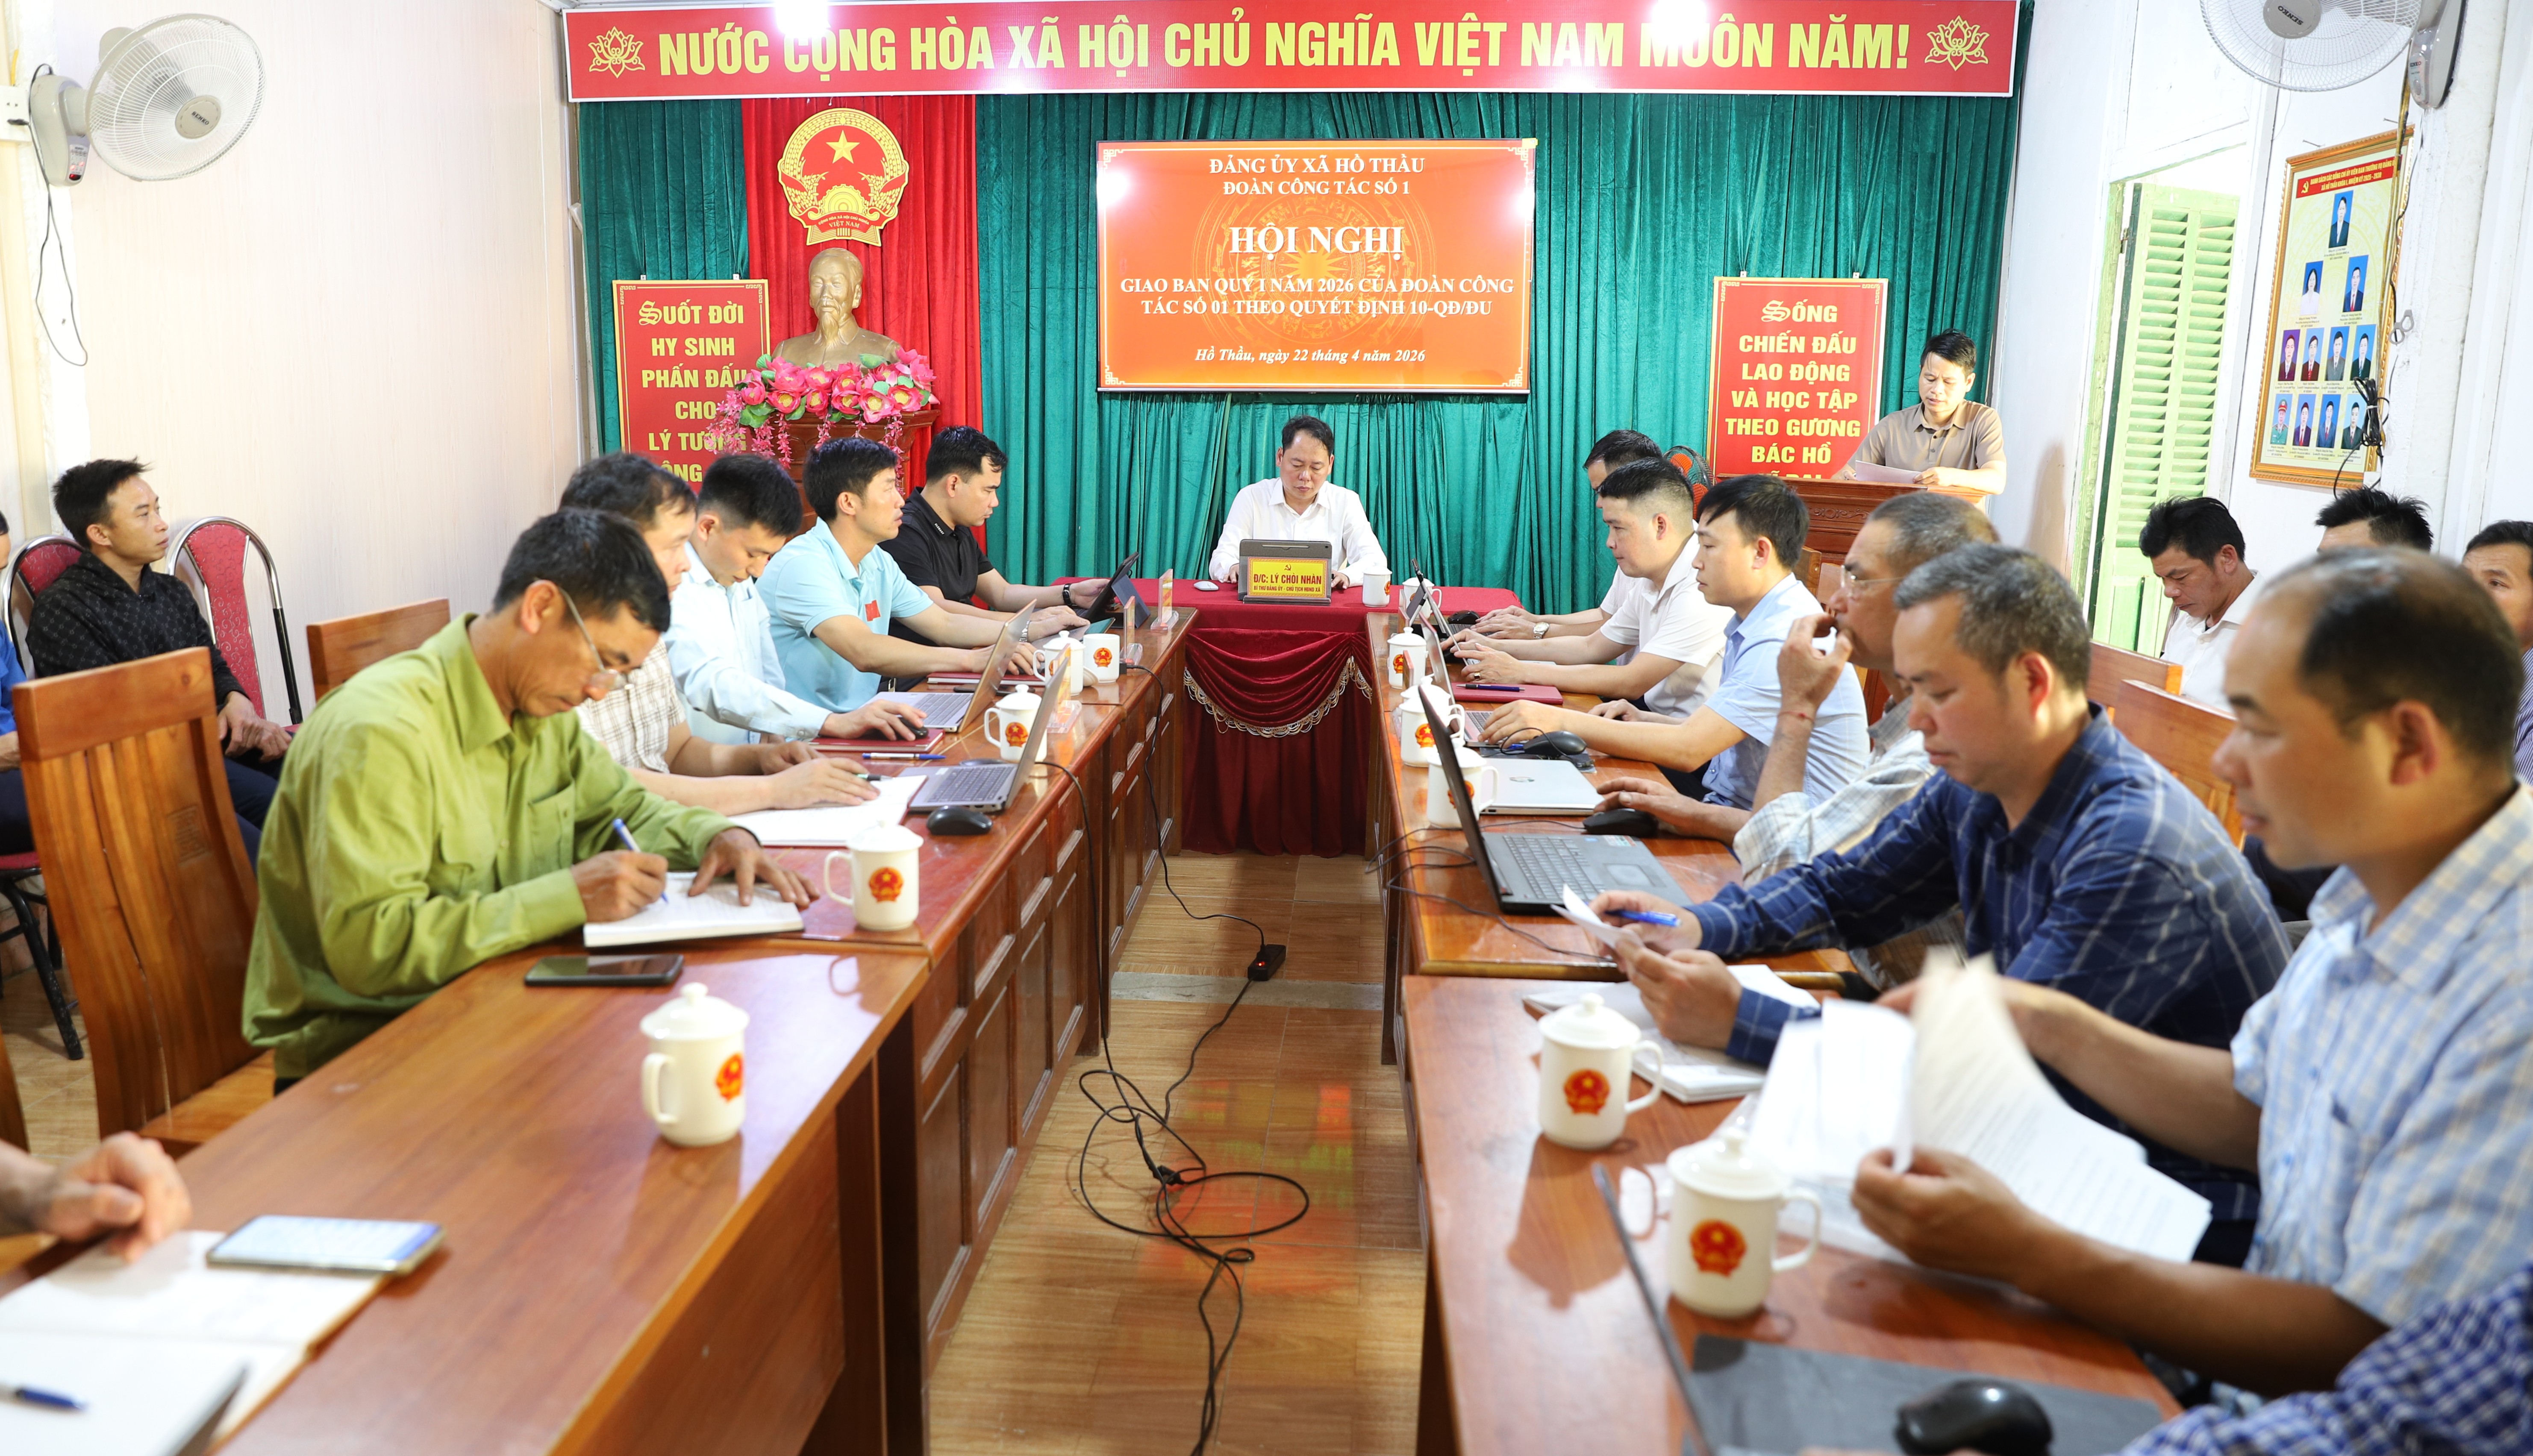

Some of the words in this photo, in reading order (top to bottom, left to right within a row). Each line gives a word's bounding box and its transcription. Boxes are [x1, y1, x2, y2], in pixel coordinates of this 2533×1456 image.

[2278, 6, 2304, 25] SENKO
[659, 23, 769, 75] NƯỚC
[911, 16, 994, 70] HÒA
[1007, 16, 1065, 68] XÃ
[1080, 15, 1148, 77] HỘI
[1165, 7, 1249, 67] CHỦ
[1266, 13, 1400, 66] NGHĨA
[1415, 13, 1507, 76] VIỆT
[1521, 23, 1624, 67] NAM
[1639, 13, 1774, 68] MUÔN
[1789, 14, 1909, 68] NĂM!
[191, 111, 209, 125] SENKO
[1210, 155, 1266, 173] ĐẢNG
[1271, 154, 1298, 173] ỦY
[1302, 155, 1330, 173] XÃ
[1336, 154, 1364, 173] HỒ
[1369, 154, 1425, 172] THẦU
[1224, 178, 1274, 194] ĐOÀN
[1278, 178, 1330, 194] CÔNG
[1334, 177, 1370, 194] TÁC
[1375, 177, 1397, 194] SỐ
[1403, 181, 1409, 194] 1
[1230, 223, 1298, 260] HỘI
[1308, 226, 1404, 260] NGHỊ
[1121, 279, 1168, 292] GIAO
[1173, 279, 1209, 292] BAN
[1215, 274, 1253, 295] QUÝ
[1259, 279, 1265, 291] I
[1270, 275, 1313, 292] NĂM
[1318, 279, 1353, 292] 2026
[1359, 273, 1397, 293] CỦA
[1401, 275, 1454, 292] ĐOÀN
[1459, 275, 1514, 293] CÔNG
[639, 299, 702, 325] SUỐT
[709, 301, 743, 323] ĐỜI
[1141, 296, 1178, 314] TÁC
[1183, 296, 1207, 314] SỐ
[1212, 300, 1228, 314] 01
[1233, 300, 1285, 314] THEO
[1290, 296, 1353, 317] QUYẾT
[1358, 301, 1405, 317] ĐỊNH
[1410, 301, 1492, 317] 10-QĐ/ĐU
[1761, 299, 1837, 322] SỐNG
[652, 338, 677, 356] HY
[685, 338, 734, 356] SINH
[1739, 330, 1805, 352] CHIẾN
[1812, 331, 1856, 354] ĐẤU
[1195, 346, 1215, 360] Hồ
[1220, 346, 1255, 362] Thầu,
[1259, 349, 1289, 364] ngày
[1293, 349, 1308, 361] 22
[1312, 349, 1348, 364] tháng
[1352, 349, 1359, 361] 4
[1363, 350, 1390, 361] năm
[1394, 350, 1425, 361] 2026
[642, 363, 698, 387] PHẤN
[1742, 364, 1783, 380] LAO
[1790, 361, 1850, 385] ĐỘNG
[676, 401, 716, 419] CHO
[1732, 387, 1759, 407] VÀ
[1766, 391, 1809, 411] HỌC
[1817, 389, 1857, 412] TẬP
[1725, 418, 1779, 435] THEO
[1787, 418, 1860, 437] GƯƠNG
[649, 429, 671, 450] LÝ
[1752, 443, 1795, 463] BÁC
[1803, 442, 1831, 464] HỒ
[1253, 574, 1268, 583] Đ/C:
[1271, 572, 1279, 583] LÝ
[1281, 572, 1298, 584] CHÒI
[1301, 573, 1321, 584] NHÀN
